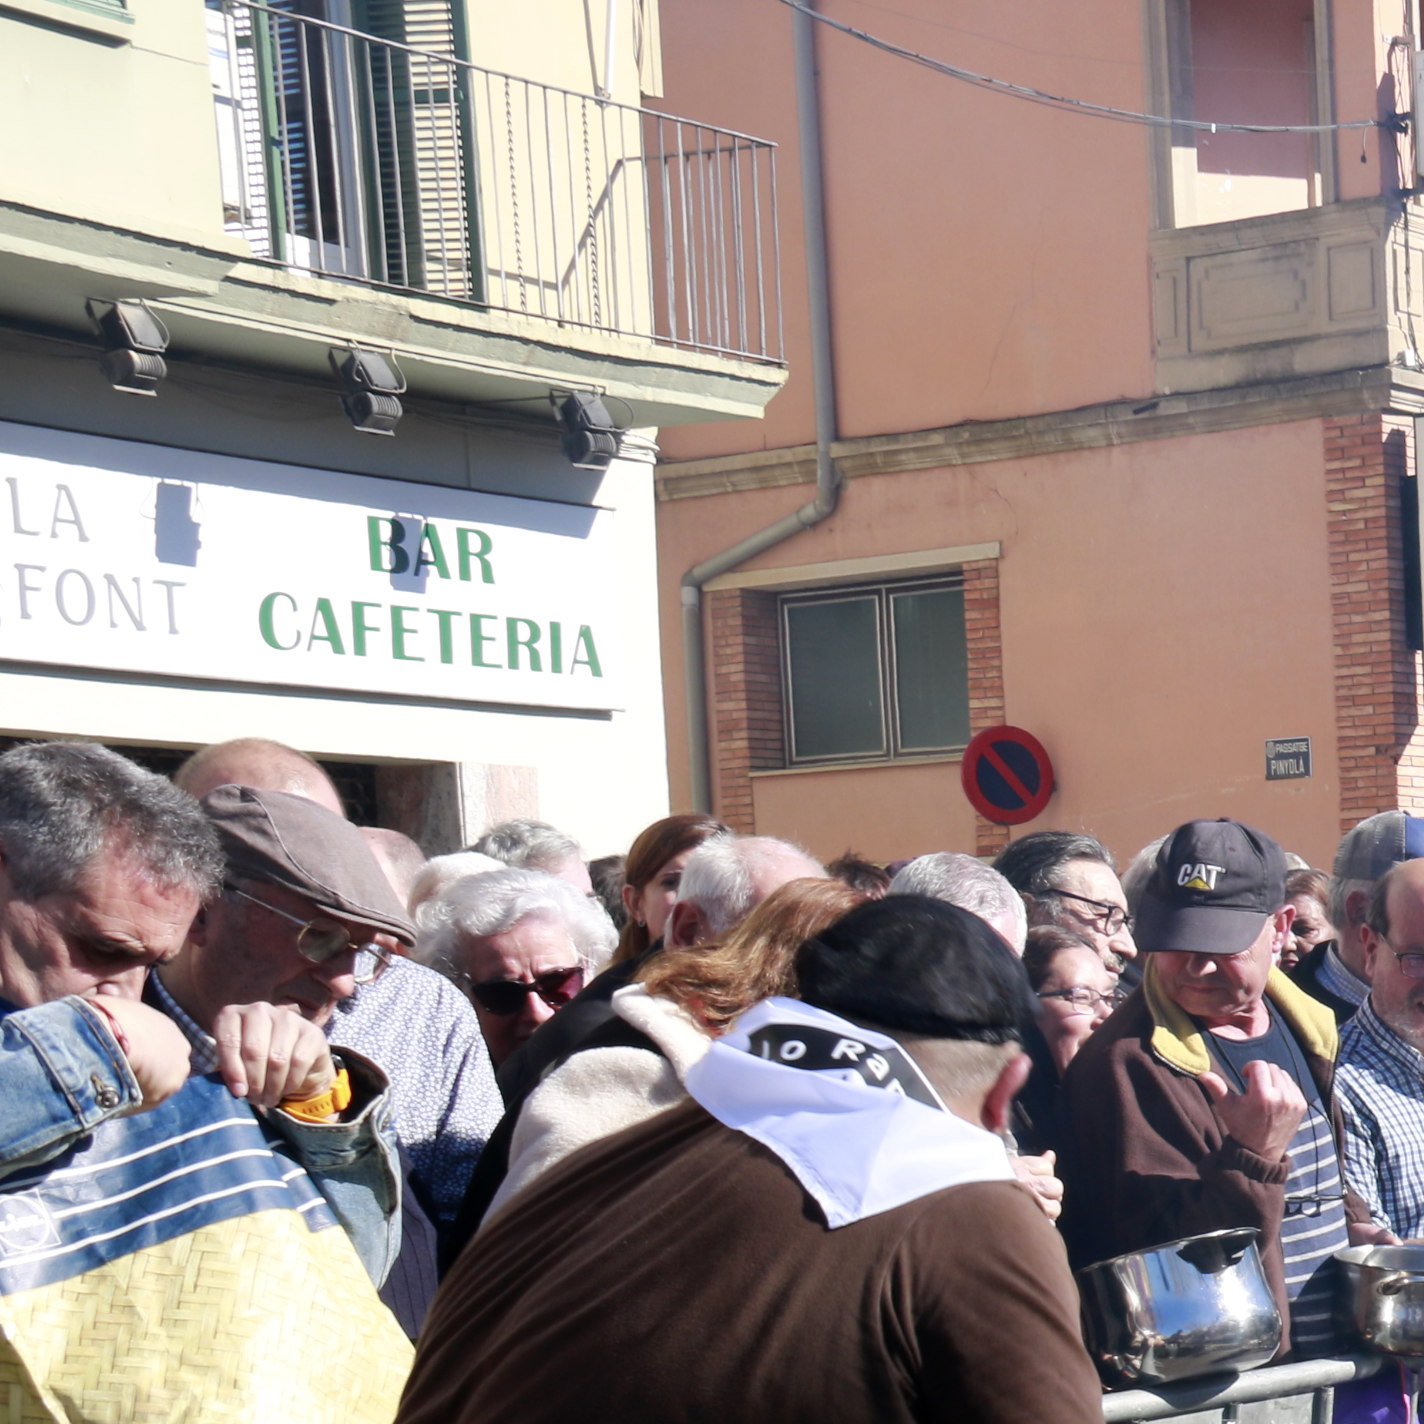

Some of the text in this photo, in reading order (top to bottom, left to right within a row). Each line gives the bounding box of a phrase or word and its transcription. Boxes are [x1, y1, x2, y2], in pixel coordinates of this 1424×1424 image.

[5, 476, 91, 543] LA
[367, 514, 497, 585] BAR
[13, 563, 188, 635] FONT
[258, 591, 604, 679] CAFETERIA
[1177, 863, 1224, 891] CAT
